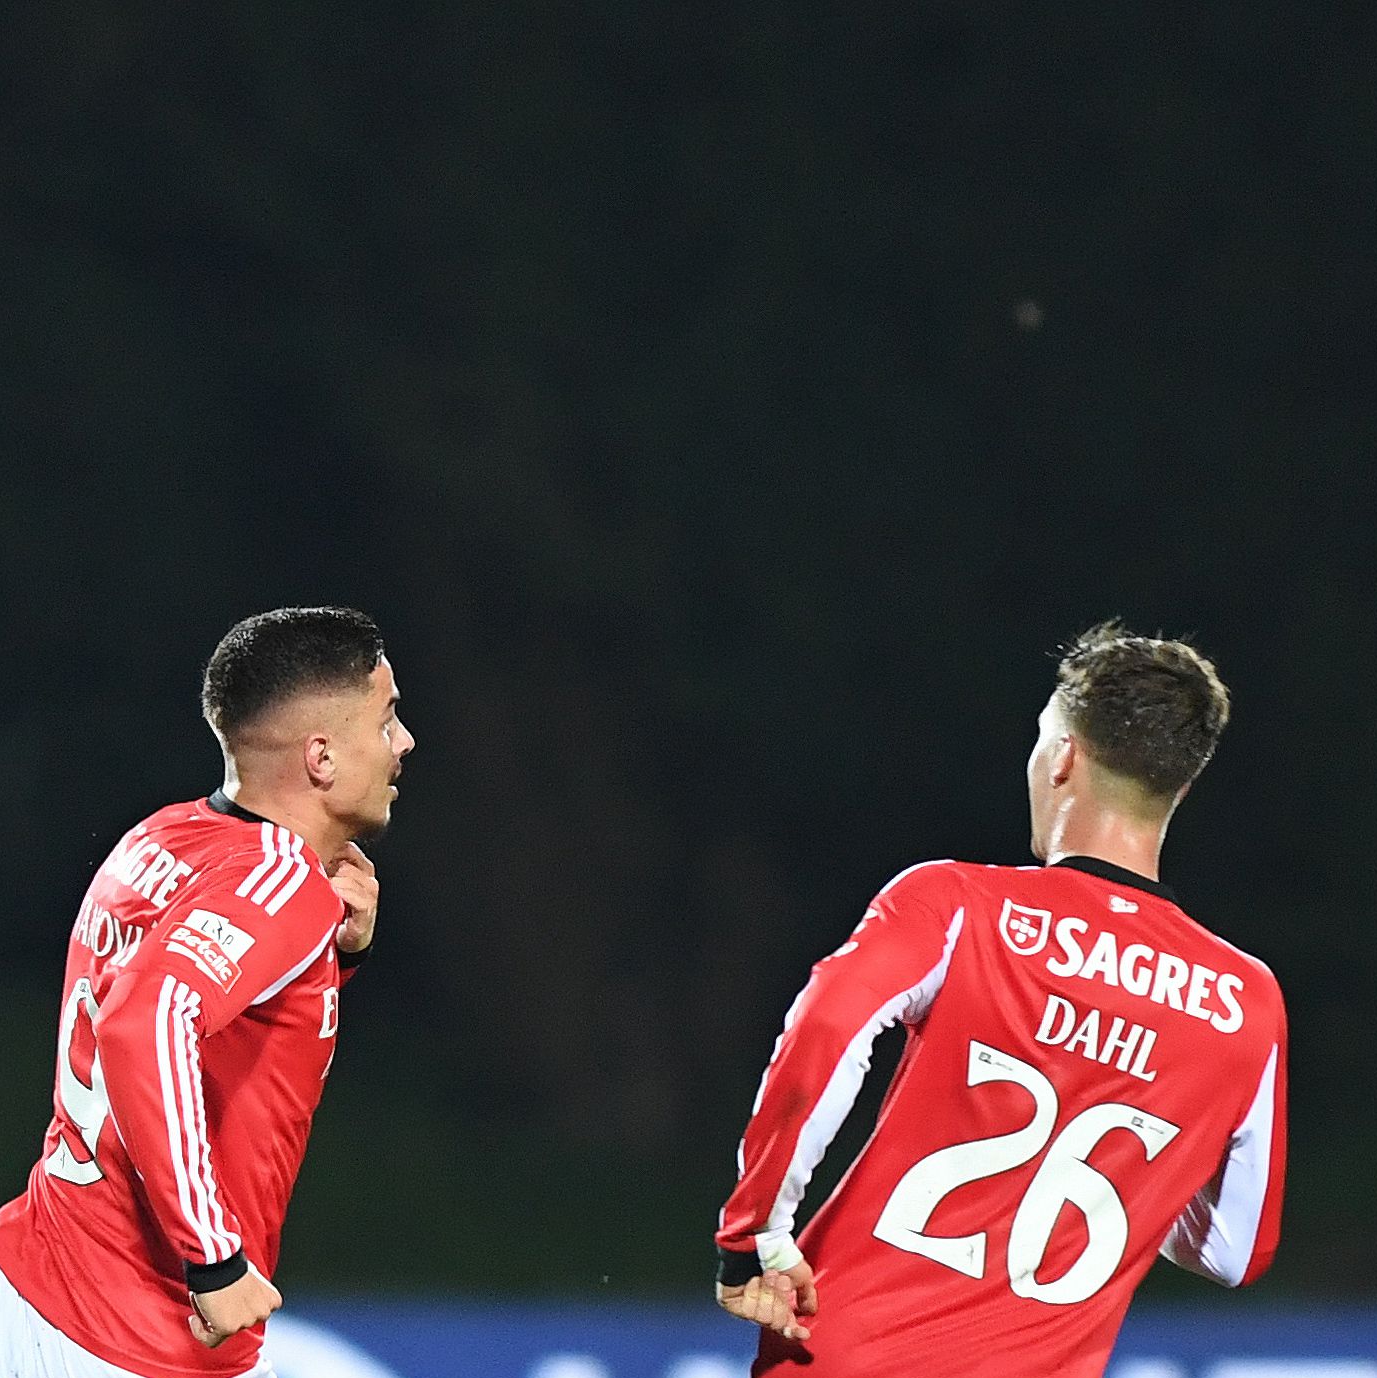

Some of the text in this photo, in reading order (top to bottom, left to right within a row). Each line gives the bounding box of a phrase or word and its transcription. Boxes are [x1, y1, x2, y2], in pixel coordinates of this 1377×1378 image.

[1034, 994, 1158, 1082] DAHL
[1046, 917, 1245, 1034] SAGRES
[45, 977, 110, 1187] 9
[872, 1040, 1181, 1305] 26
